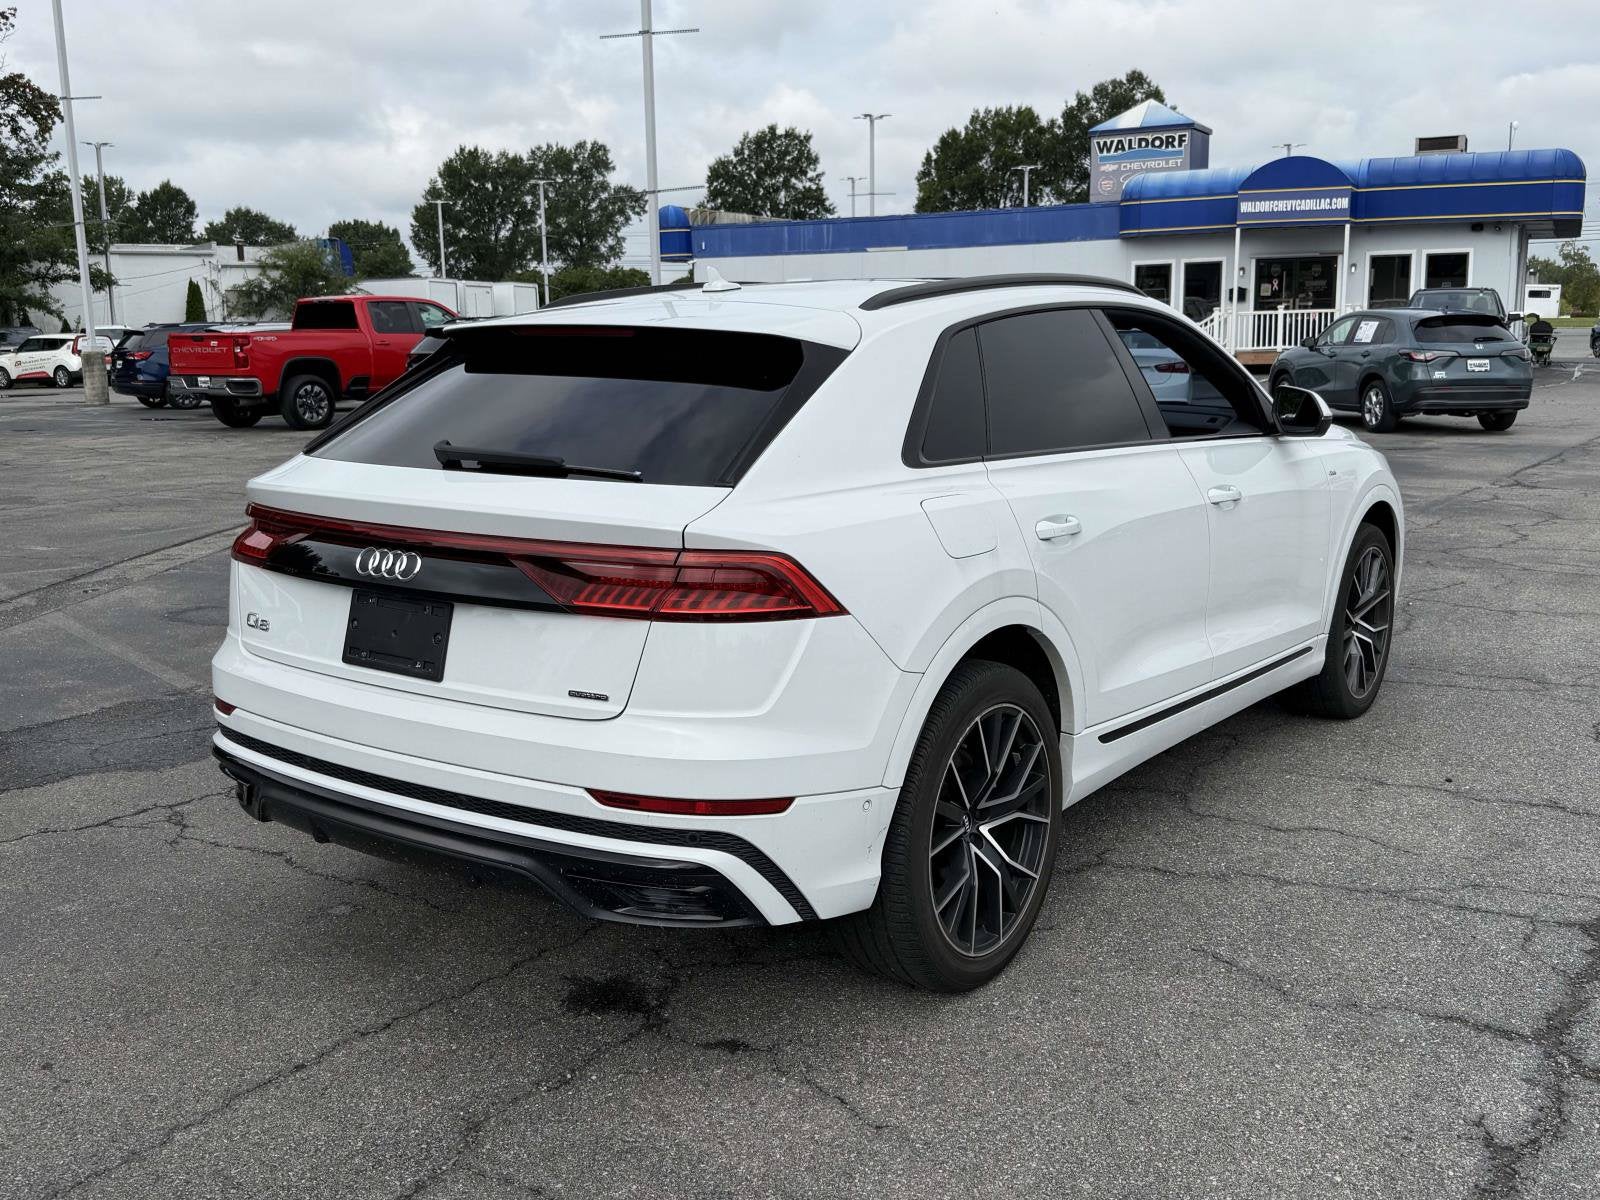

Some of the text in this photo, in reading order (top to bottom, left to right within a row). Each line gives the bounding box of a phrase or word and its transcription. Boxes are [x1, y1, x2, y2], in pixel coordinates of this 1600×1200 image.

[1095, 133, 1188, 155] WALDORF
[1120, 159, 1183, 171] CHEVROLET
[1240, 197, 1349, 213] WALDORFCHEVYCADILLAC.COM
[246, 611, 270, 632] Q8
